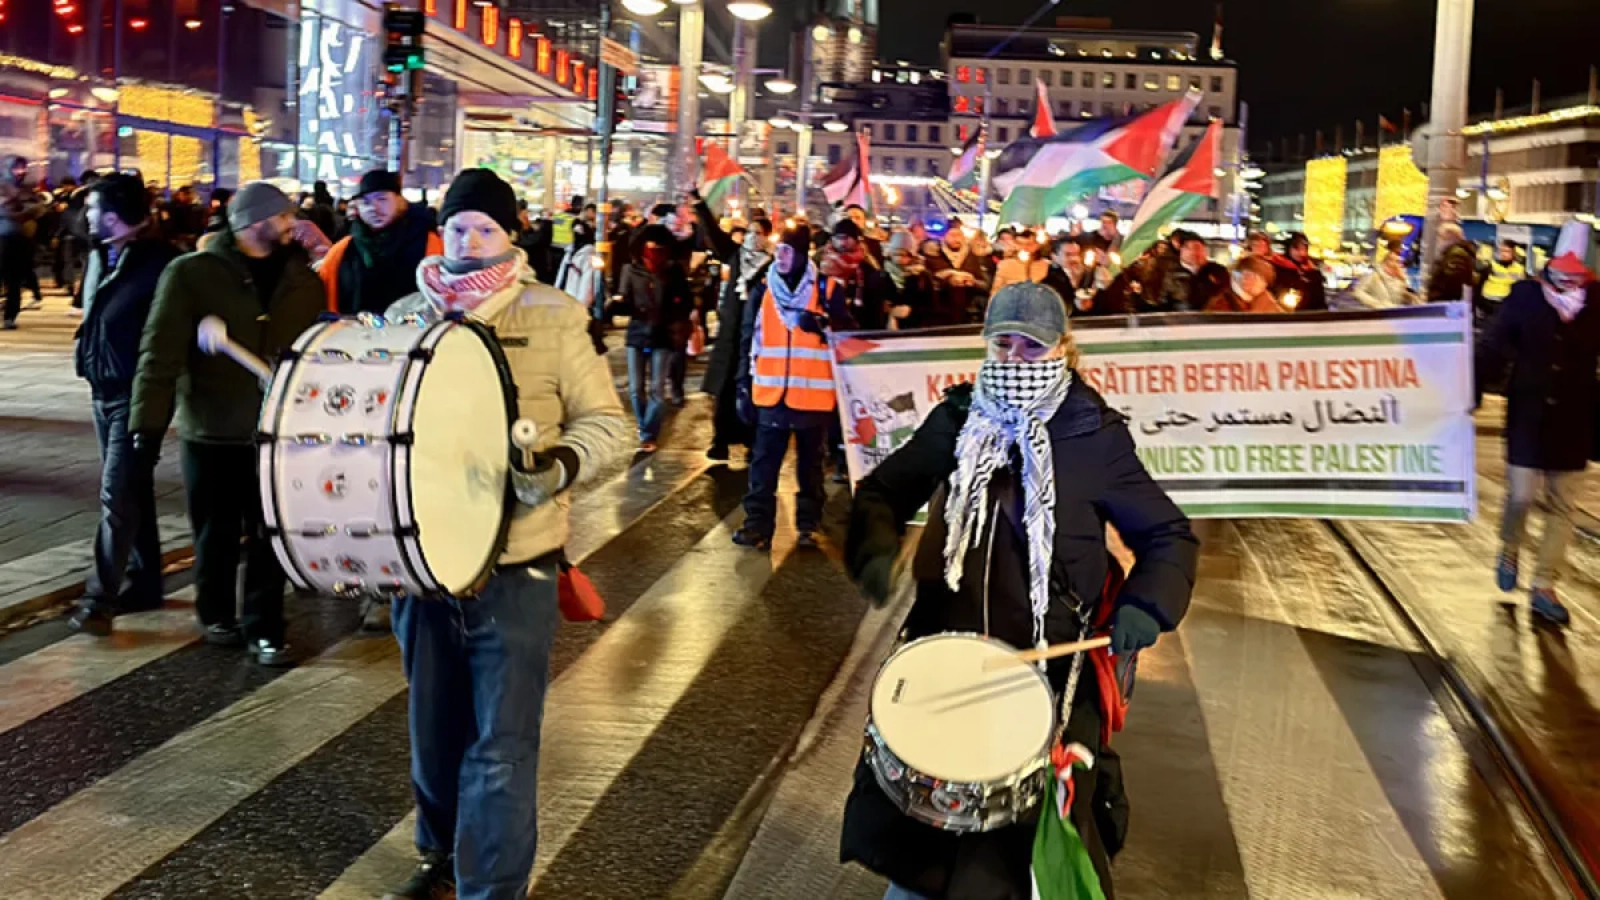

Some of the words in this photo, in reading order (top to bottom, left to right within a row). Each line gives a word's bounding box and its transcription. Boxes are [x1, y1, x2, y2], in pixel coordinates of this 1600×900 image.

[1184, 361, 1272, 392] BEFRIA
[1278, 358, 1421, 390] PALESTINA
[1140, 409, 1200, 435] حتى
[1205, 408, 1294, 433] مستمر
[1302, 394, 1400, 433] النضال
[1208, 445, 1239, 474] TO
[1245, 444, 1306, 473] FREE
[1311, 444, 1444, 474] PALESTINE
